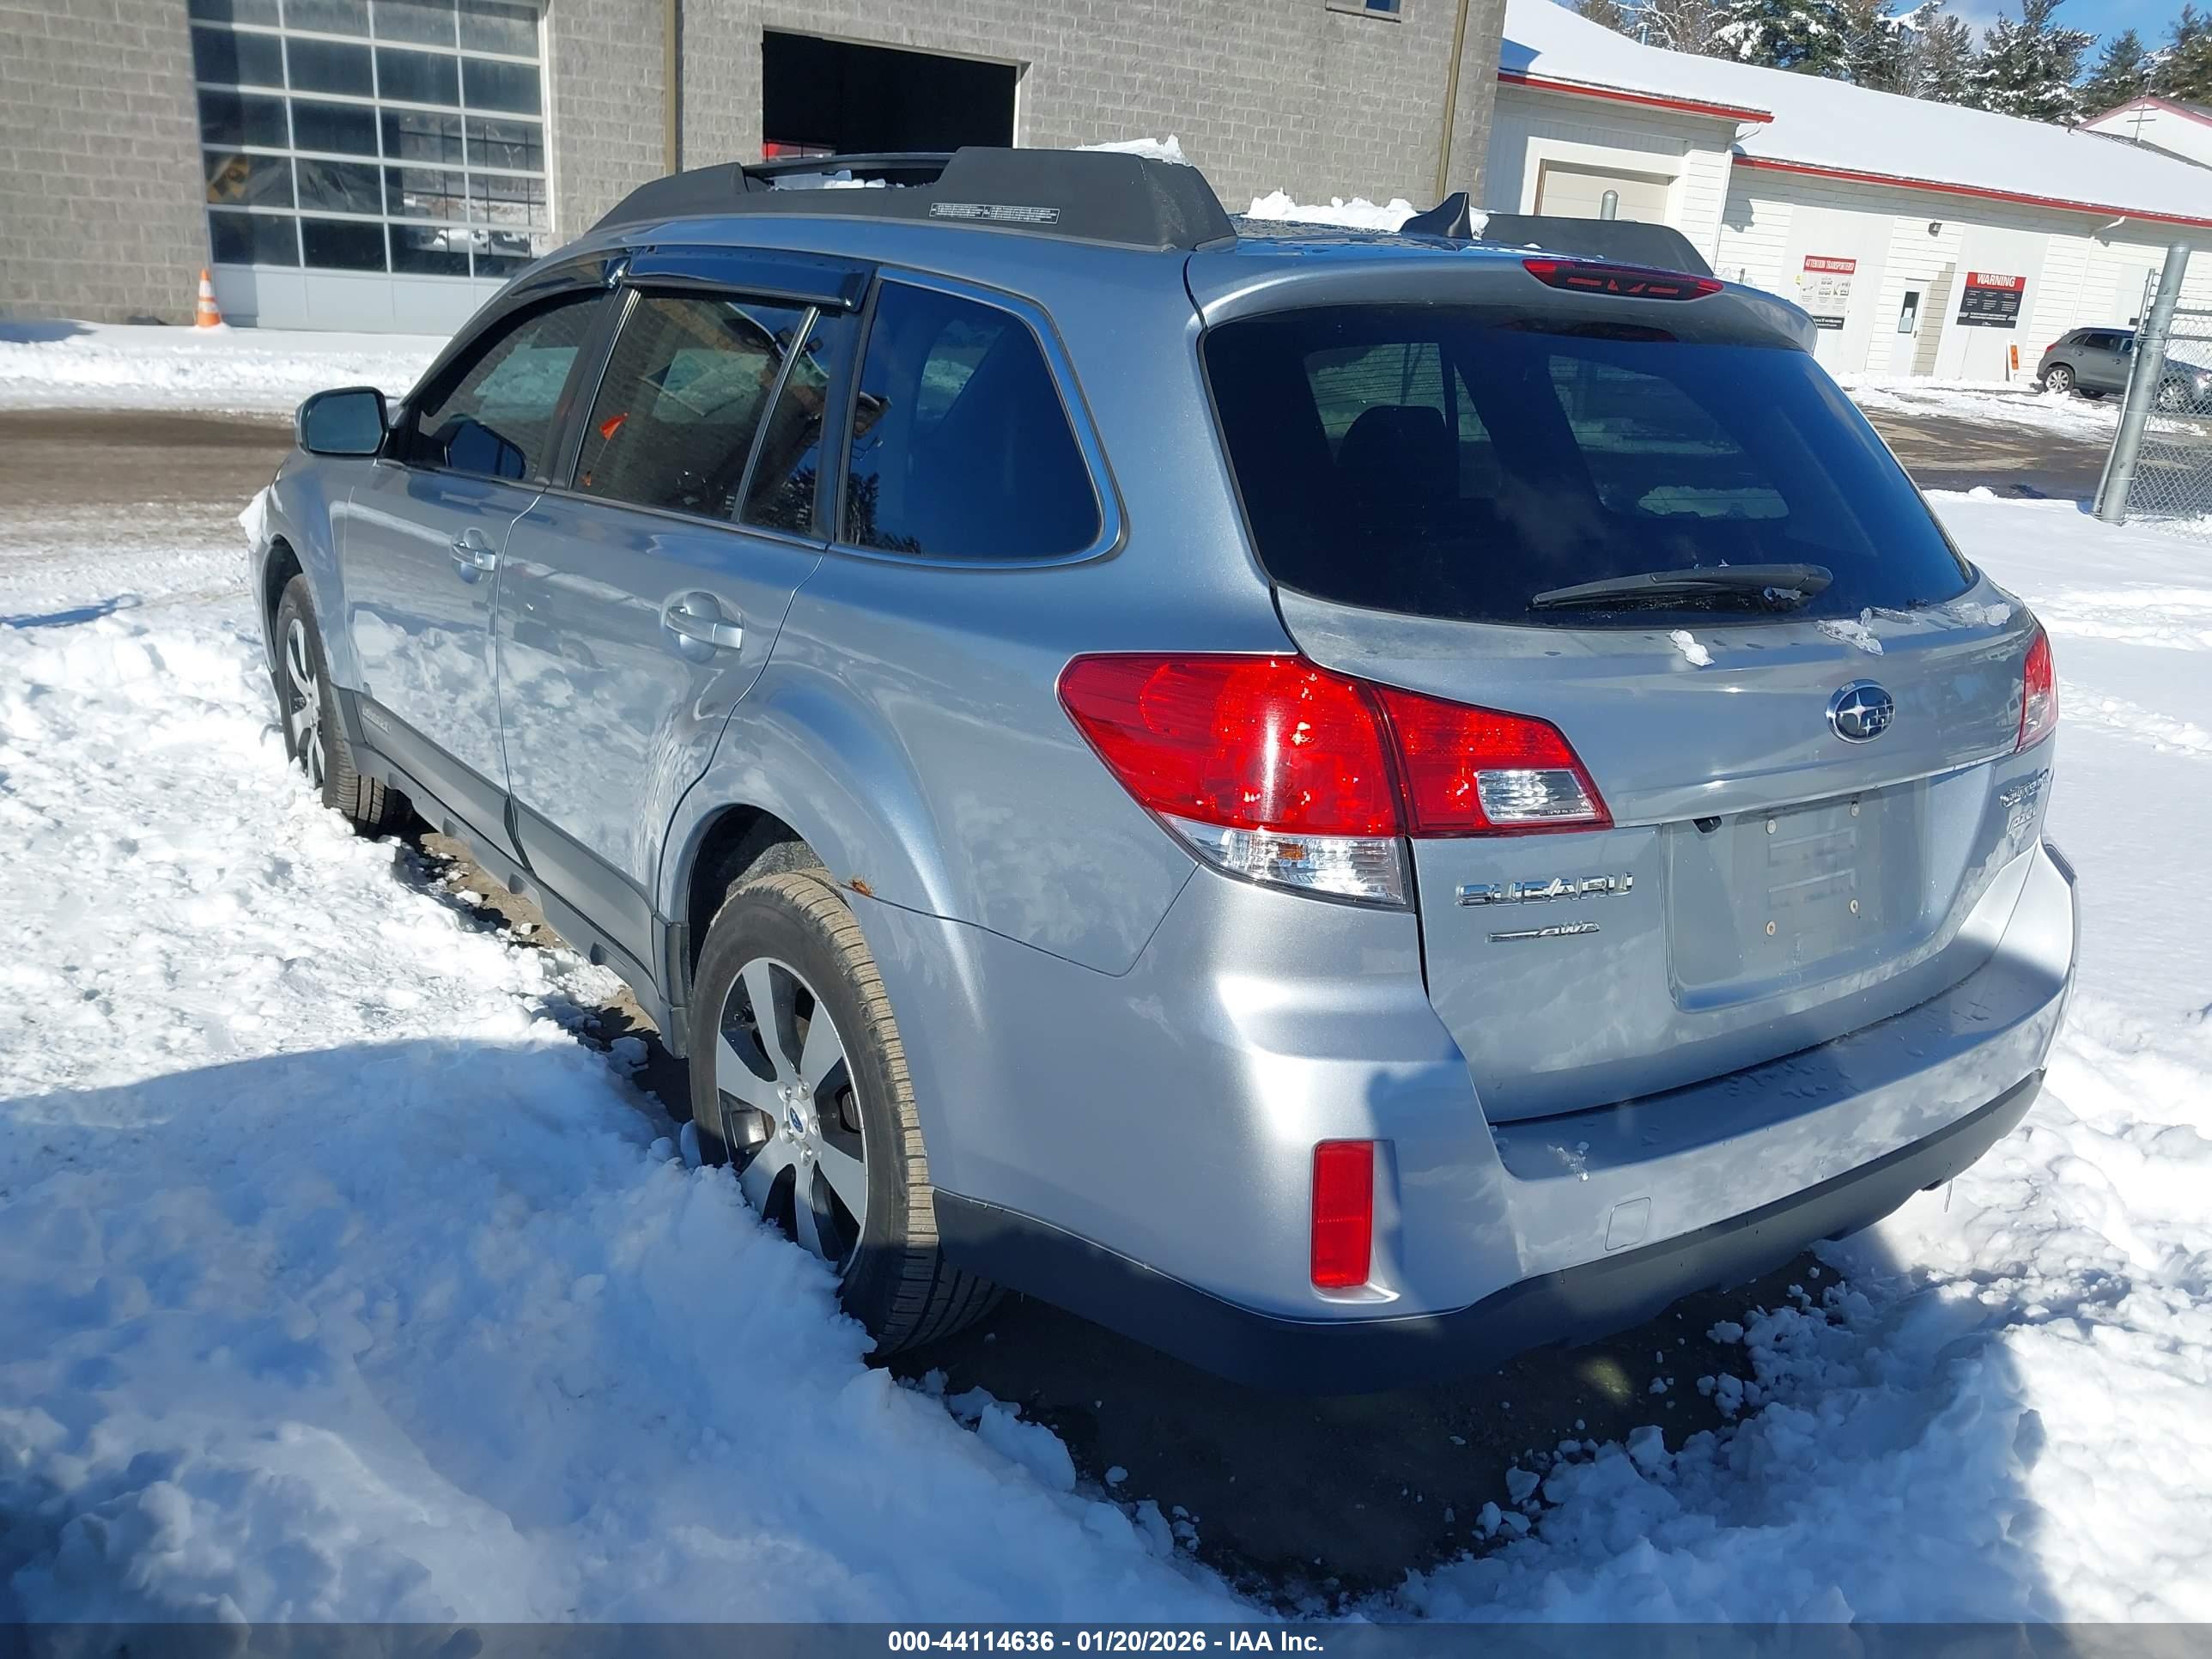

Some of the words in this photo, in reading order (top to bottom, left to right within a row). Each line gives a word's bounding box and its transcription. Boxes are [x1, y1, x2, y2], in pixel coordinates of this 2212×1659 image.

[1977, 273, 2016, 288] WARNING
[1455, 872, 1635, 908] SUBARU
[1536, 921, 1601, 938] AWD
